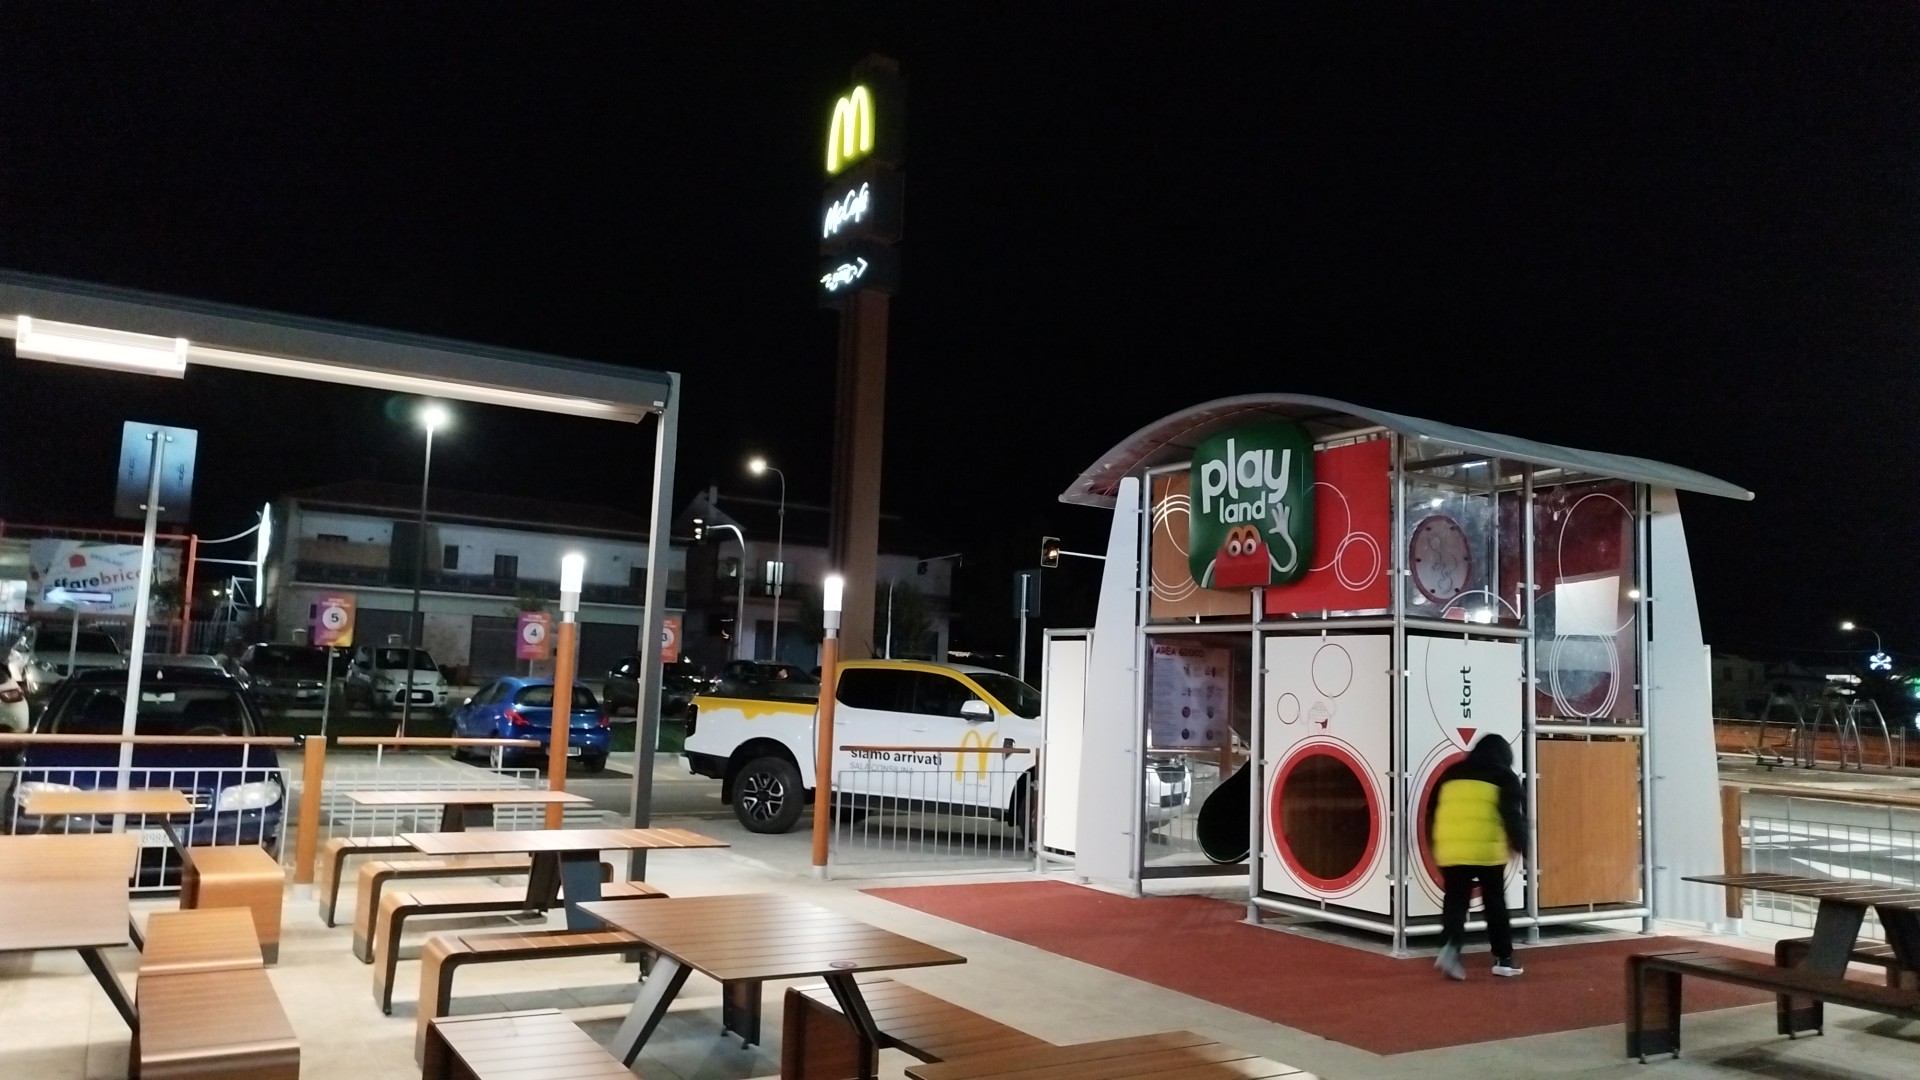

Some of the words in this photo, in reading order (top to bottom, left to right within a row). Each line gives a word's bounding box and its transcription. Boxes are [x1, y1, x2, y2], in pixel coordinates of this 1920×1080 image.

[1201, 438, 1291, 514] play
[1219, 490, 1266, 524] land
[53, 568, 141, 588] ffarebric
[331, 612, 339, 623] 5
[530, 628, 538, 637] 4
[1155, 646, 1177, 656] AREA
[1460, 665, 1471, 718] start
[850, 761, 870, 770] SALA
[851, 749, 891, 761] siamo
[894, 750, 942, 766] arrivati
